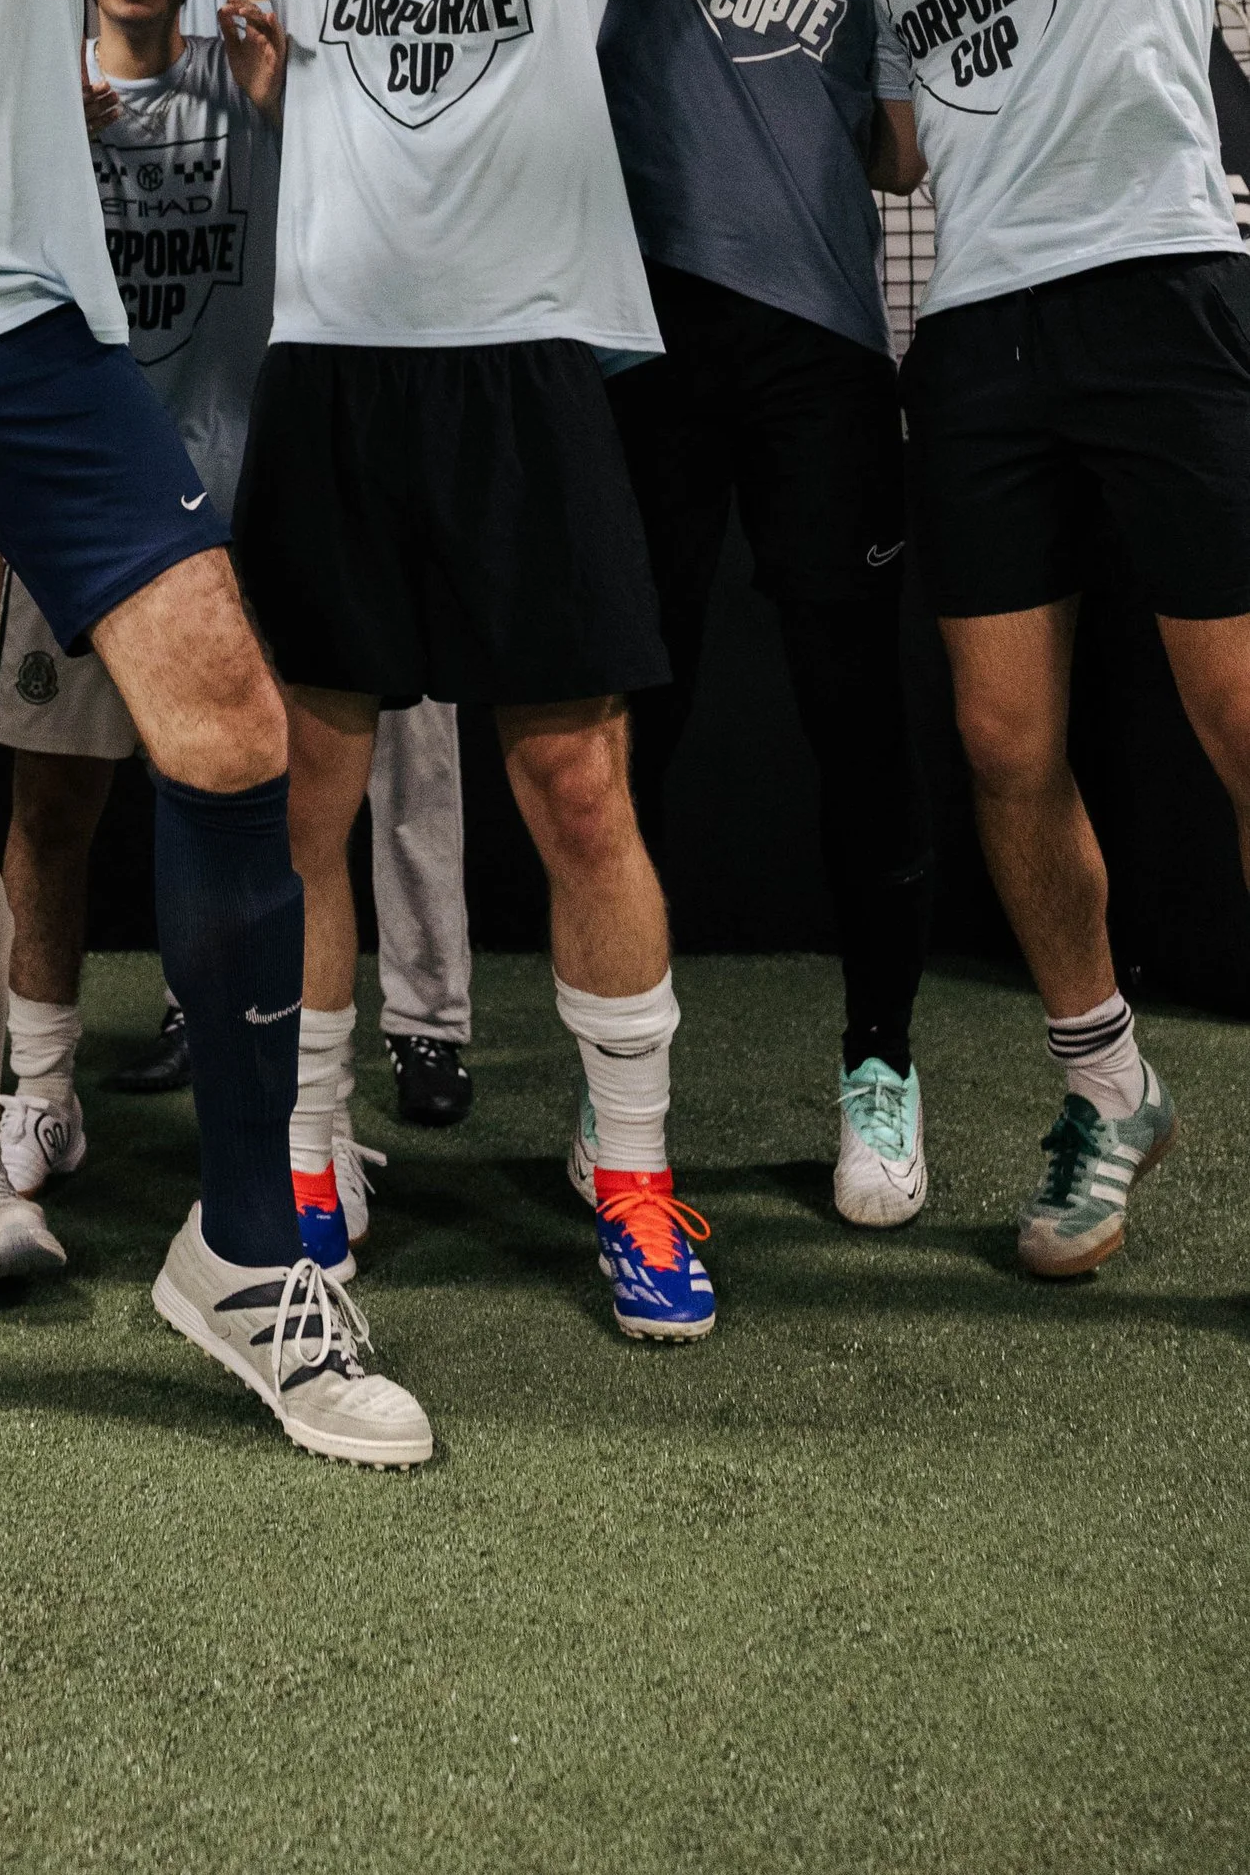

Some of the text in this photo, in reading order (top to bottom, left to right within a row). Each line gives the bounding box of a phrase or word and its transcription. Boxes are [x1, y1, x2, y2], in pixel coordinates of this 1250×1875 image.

[387, 42, 455, 96] CUP
[951, 14, 1020, 88] CUP
[105, 223, 237, 279] RPORATE
[119, 282, 186, 331] CUP
